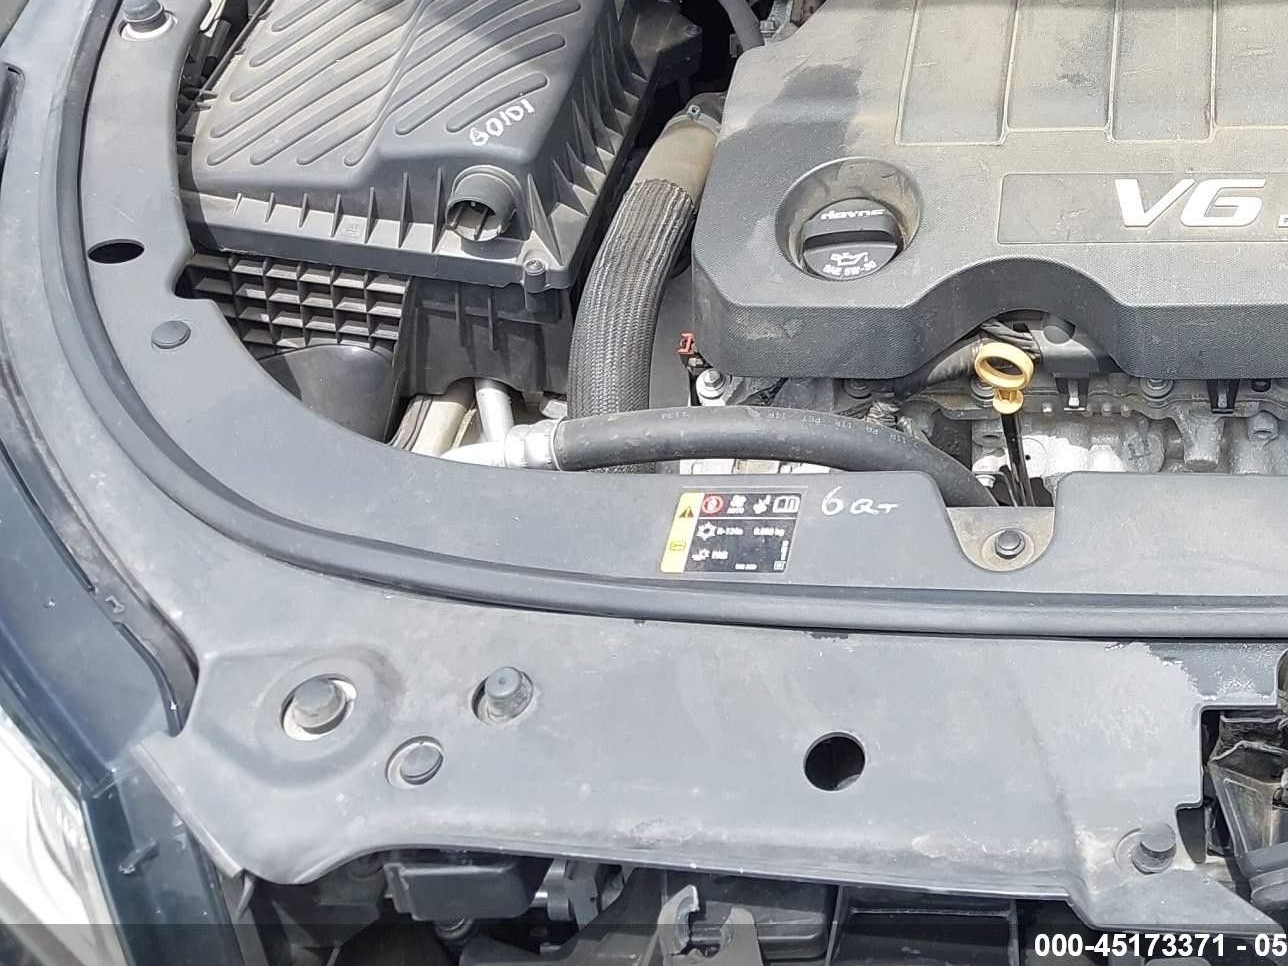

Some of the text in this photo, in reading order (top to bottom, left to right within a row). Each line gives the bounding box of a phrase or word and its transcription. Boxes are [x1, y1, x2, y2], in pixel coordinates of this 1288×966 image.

[1113, 177, 1267, 228] V6
[844, 260, 877, 276] 5W-30
[821, 485, 844, 516] 6
